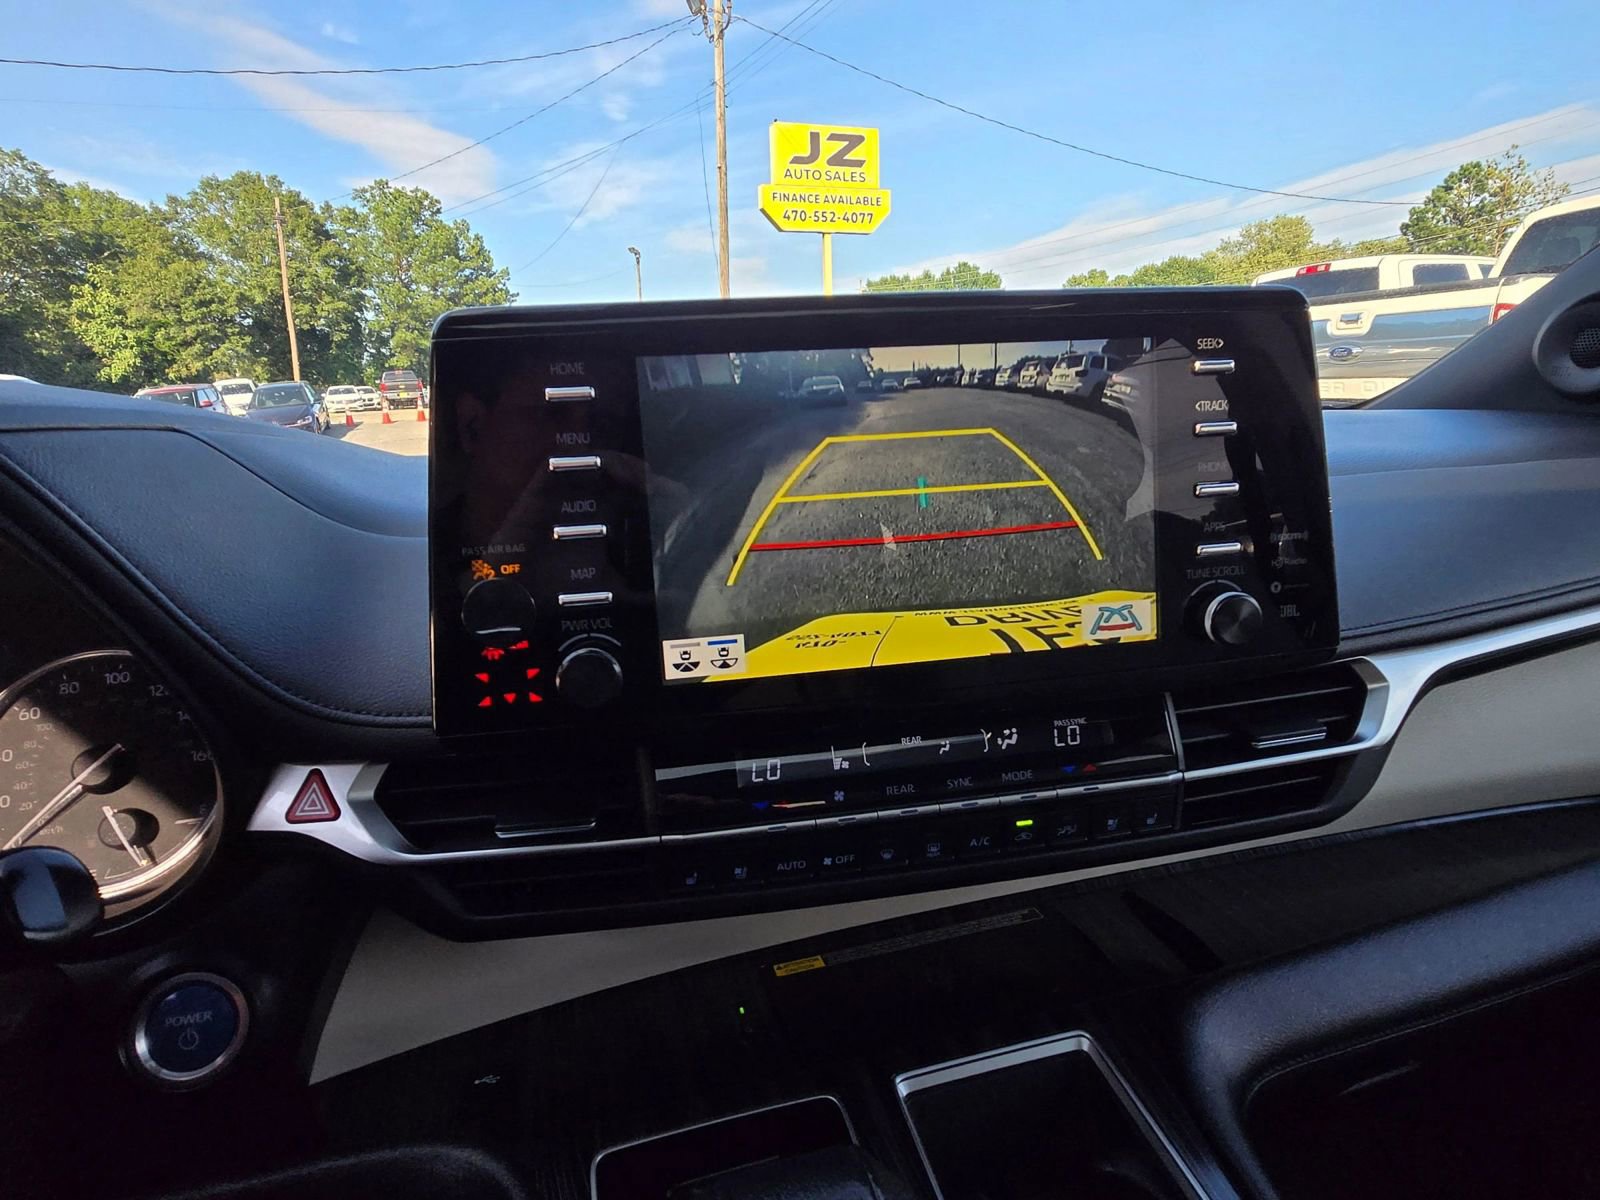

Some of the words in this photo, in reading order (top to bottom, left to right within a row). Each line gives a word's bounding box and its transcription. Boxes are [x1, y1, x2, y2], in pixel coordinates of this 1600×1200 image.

[789, 131, 867, 168] JZ
[784, 168, 822, 181] AUTO
[825, 171, 866, 183] SALES
[772, 192, 821, 204] FINANCE
[823, 195, 882, 207] AVAILABLE
[783, 209, 874, 224] 470-552-4077
[550, 362, 585, 376] HOME
[556, 432, 591, 445] MENU
[561, 500, 596, 513] AUDIO
[500, 563, 521, 575] OFF
[570, 567, 596, 580] MAP
[1187, 567, 1211, 580] TUNE
[1212, 565, 1245, 577] SCROLL
[1280, 604, 1301, 617] JBL
[561, 619, 589, 632] PWR
[590, 617, 613, 629] VOL
[104, 672, 131, 685] 100
[59, 682, 80, 695] 80
[19, 707, 40, 721] 60
[901, 736, 923, 746] REAR
[947, 776, 974, 789] SYNC
[1001, 769, 1033, 783] MODE
[886, 784, 916, 796] REAR
[970, 836, 991, 847] A/C
[777, 859, 807, 871] AUTO
[835, 853, 856, 865] OFF
[165, 1010, 214, 1027] POWER
